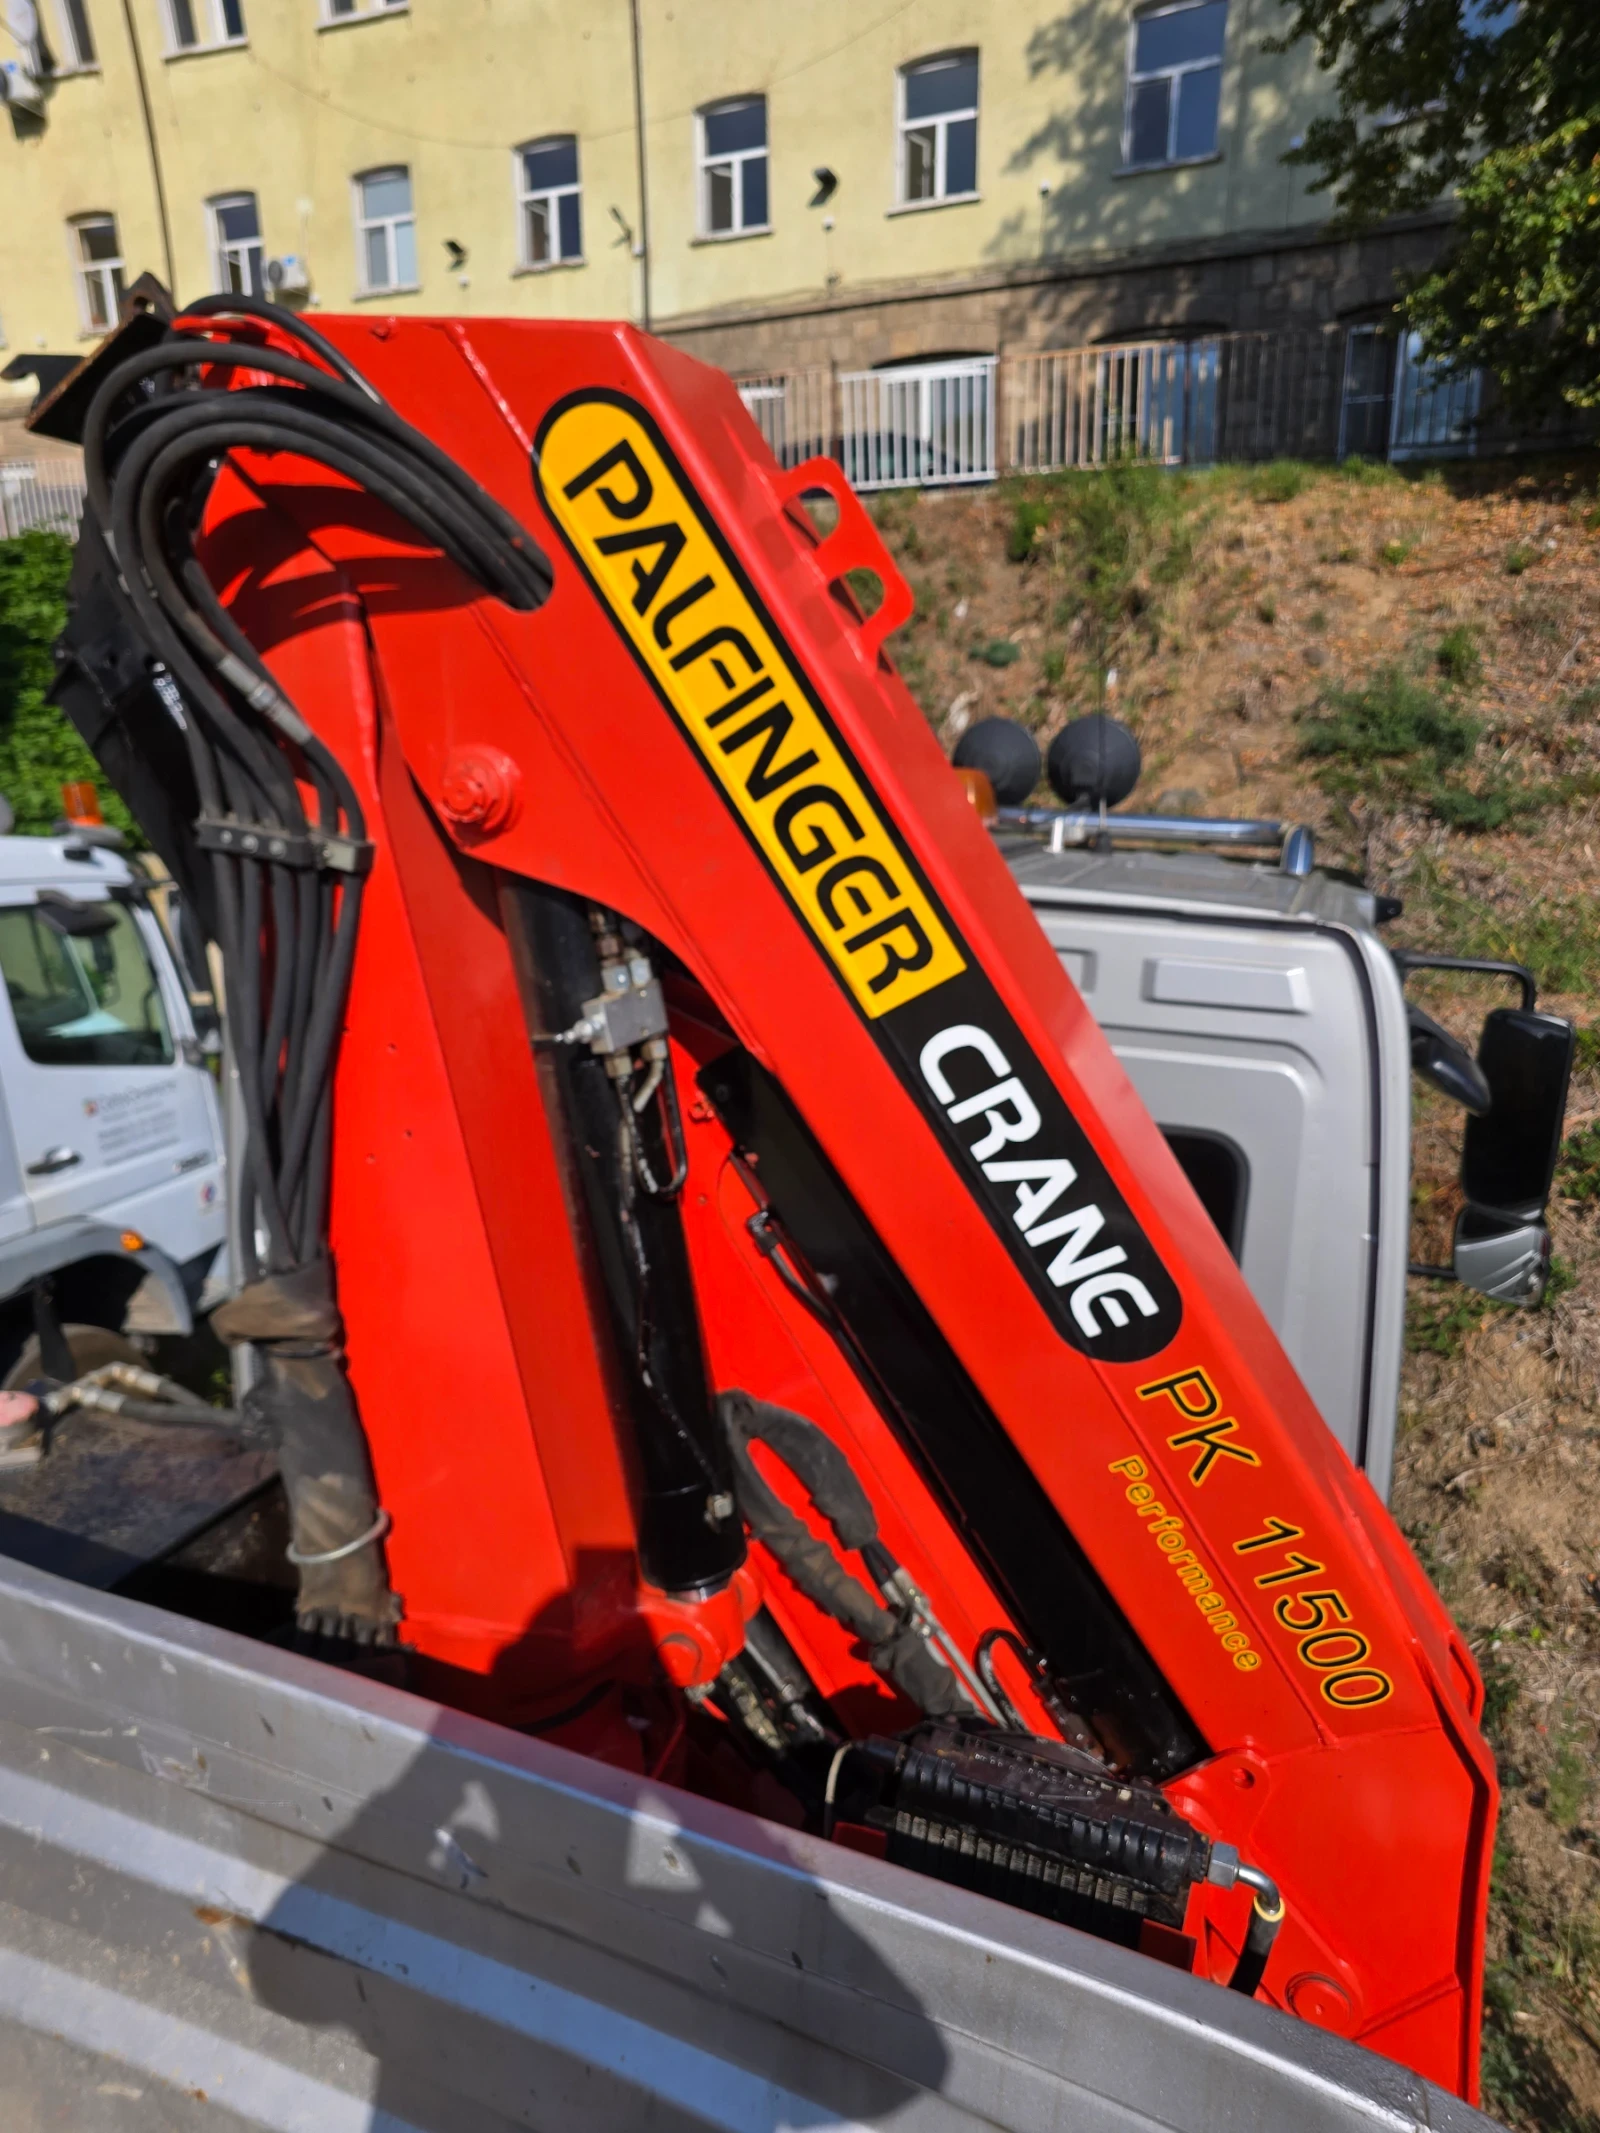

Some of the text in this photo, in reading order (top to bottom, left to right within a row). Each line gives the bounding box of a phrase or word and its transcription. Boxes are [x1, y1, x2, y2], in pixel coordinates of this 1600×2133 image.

[562, 438, 1160, 1338] PALFINGER CRANE
[1108, 1455, 1262, 1671] Performance
[1136, 1365, 1394, 1708] PK 11500
